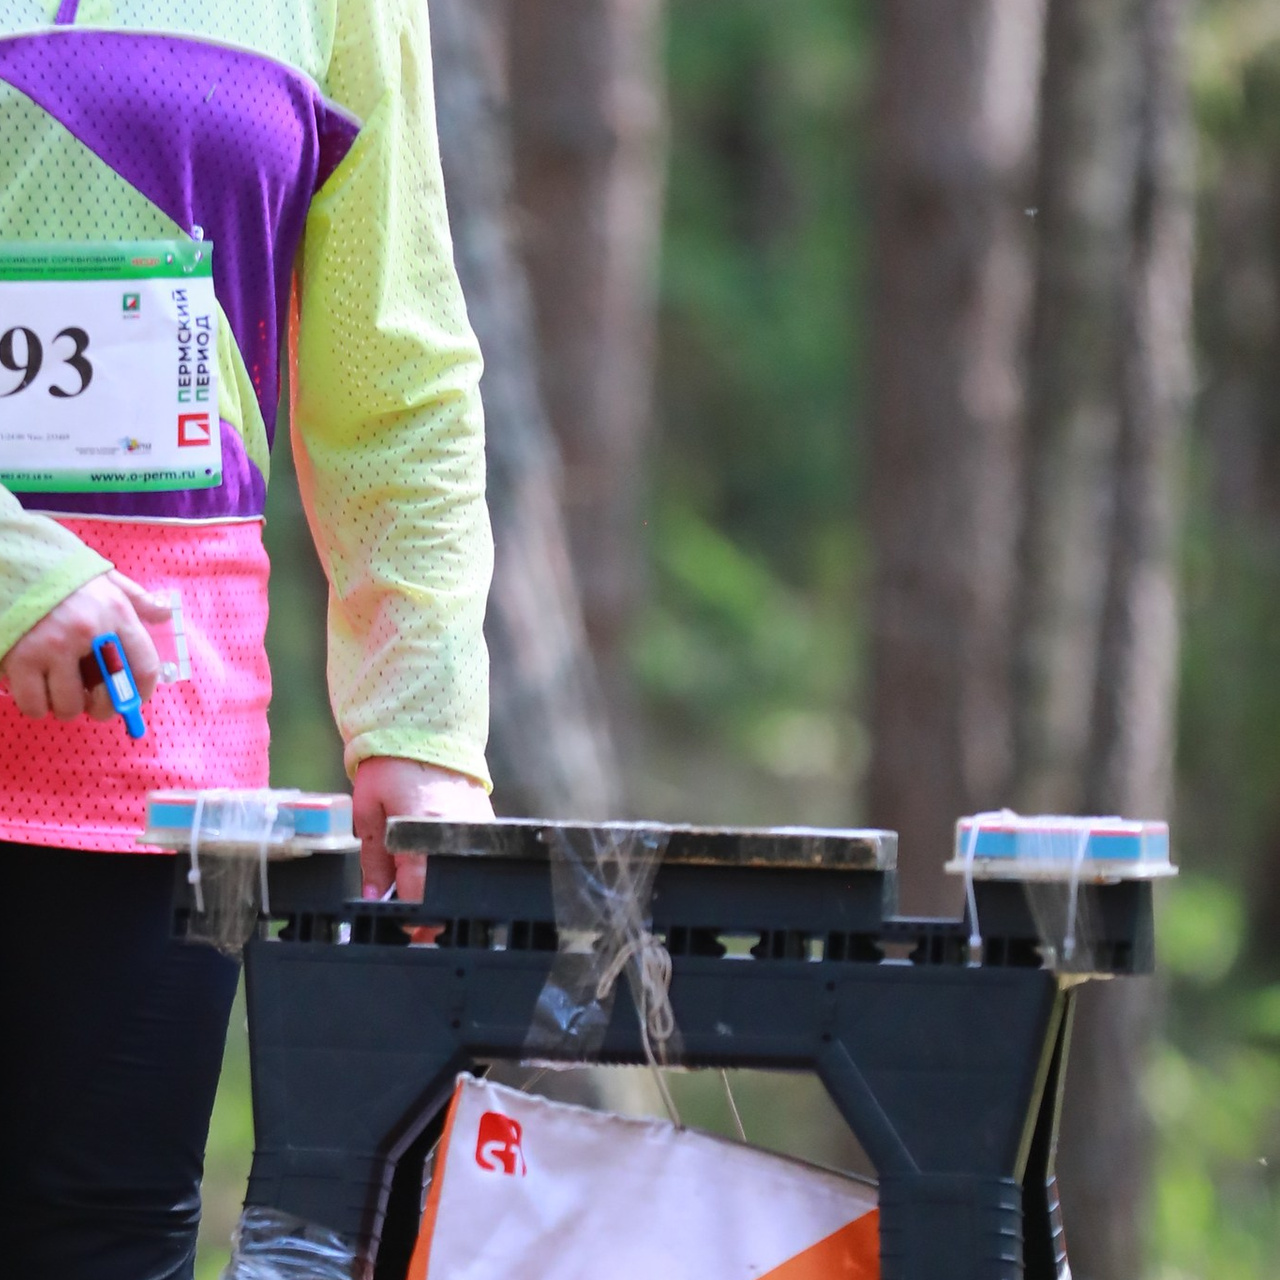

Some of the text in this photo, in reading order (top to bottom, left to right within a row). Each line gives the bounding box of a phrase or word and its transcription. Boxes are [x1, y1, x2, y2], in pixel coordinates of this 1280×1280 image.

[172, 288, 192, 403] ПЕРМСКИЙ
[195, 314, 211, 402] ПЕРИОД
[90, 469, 196, 483] www.o-perm.ru
